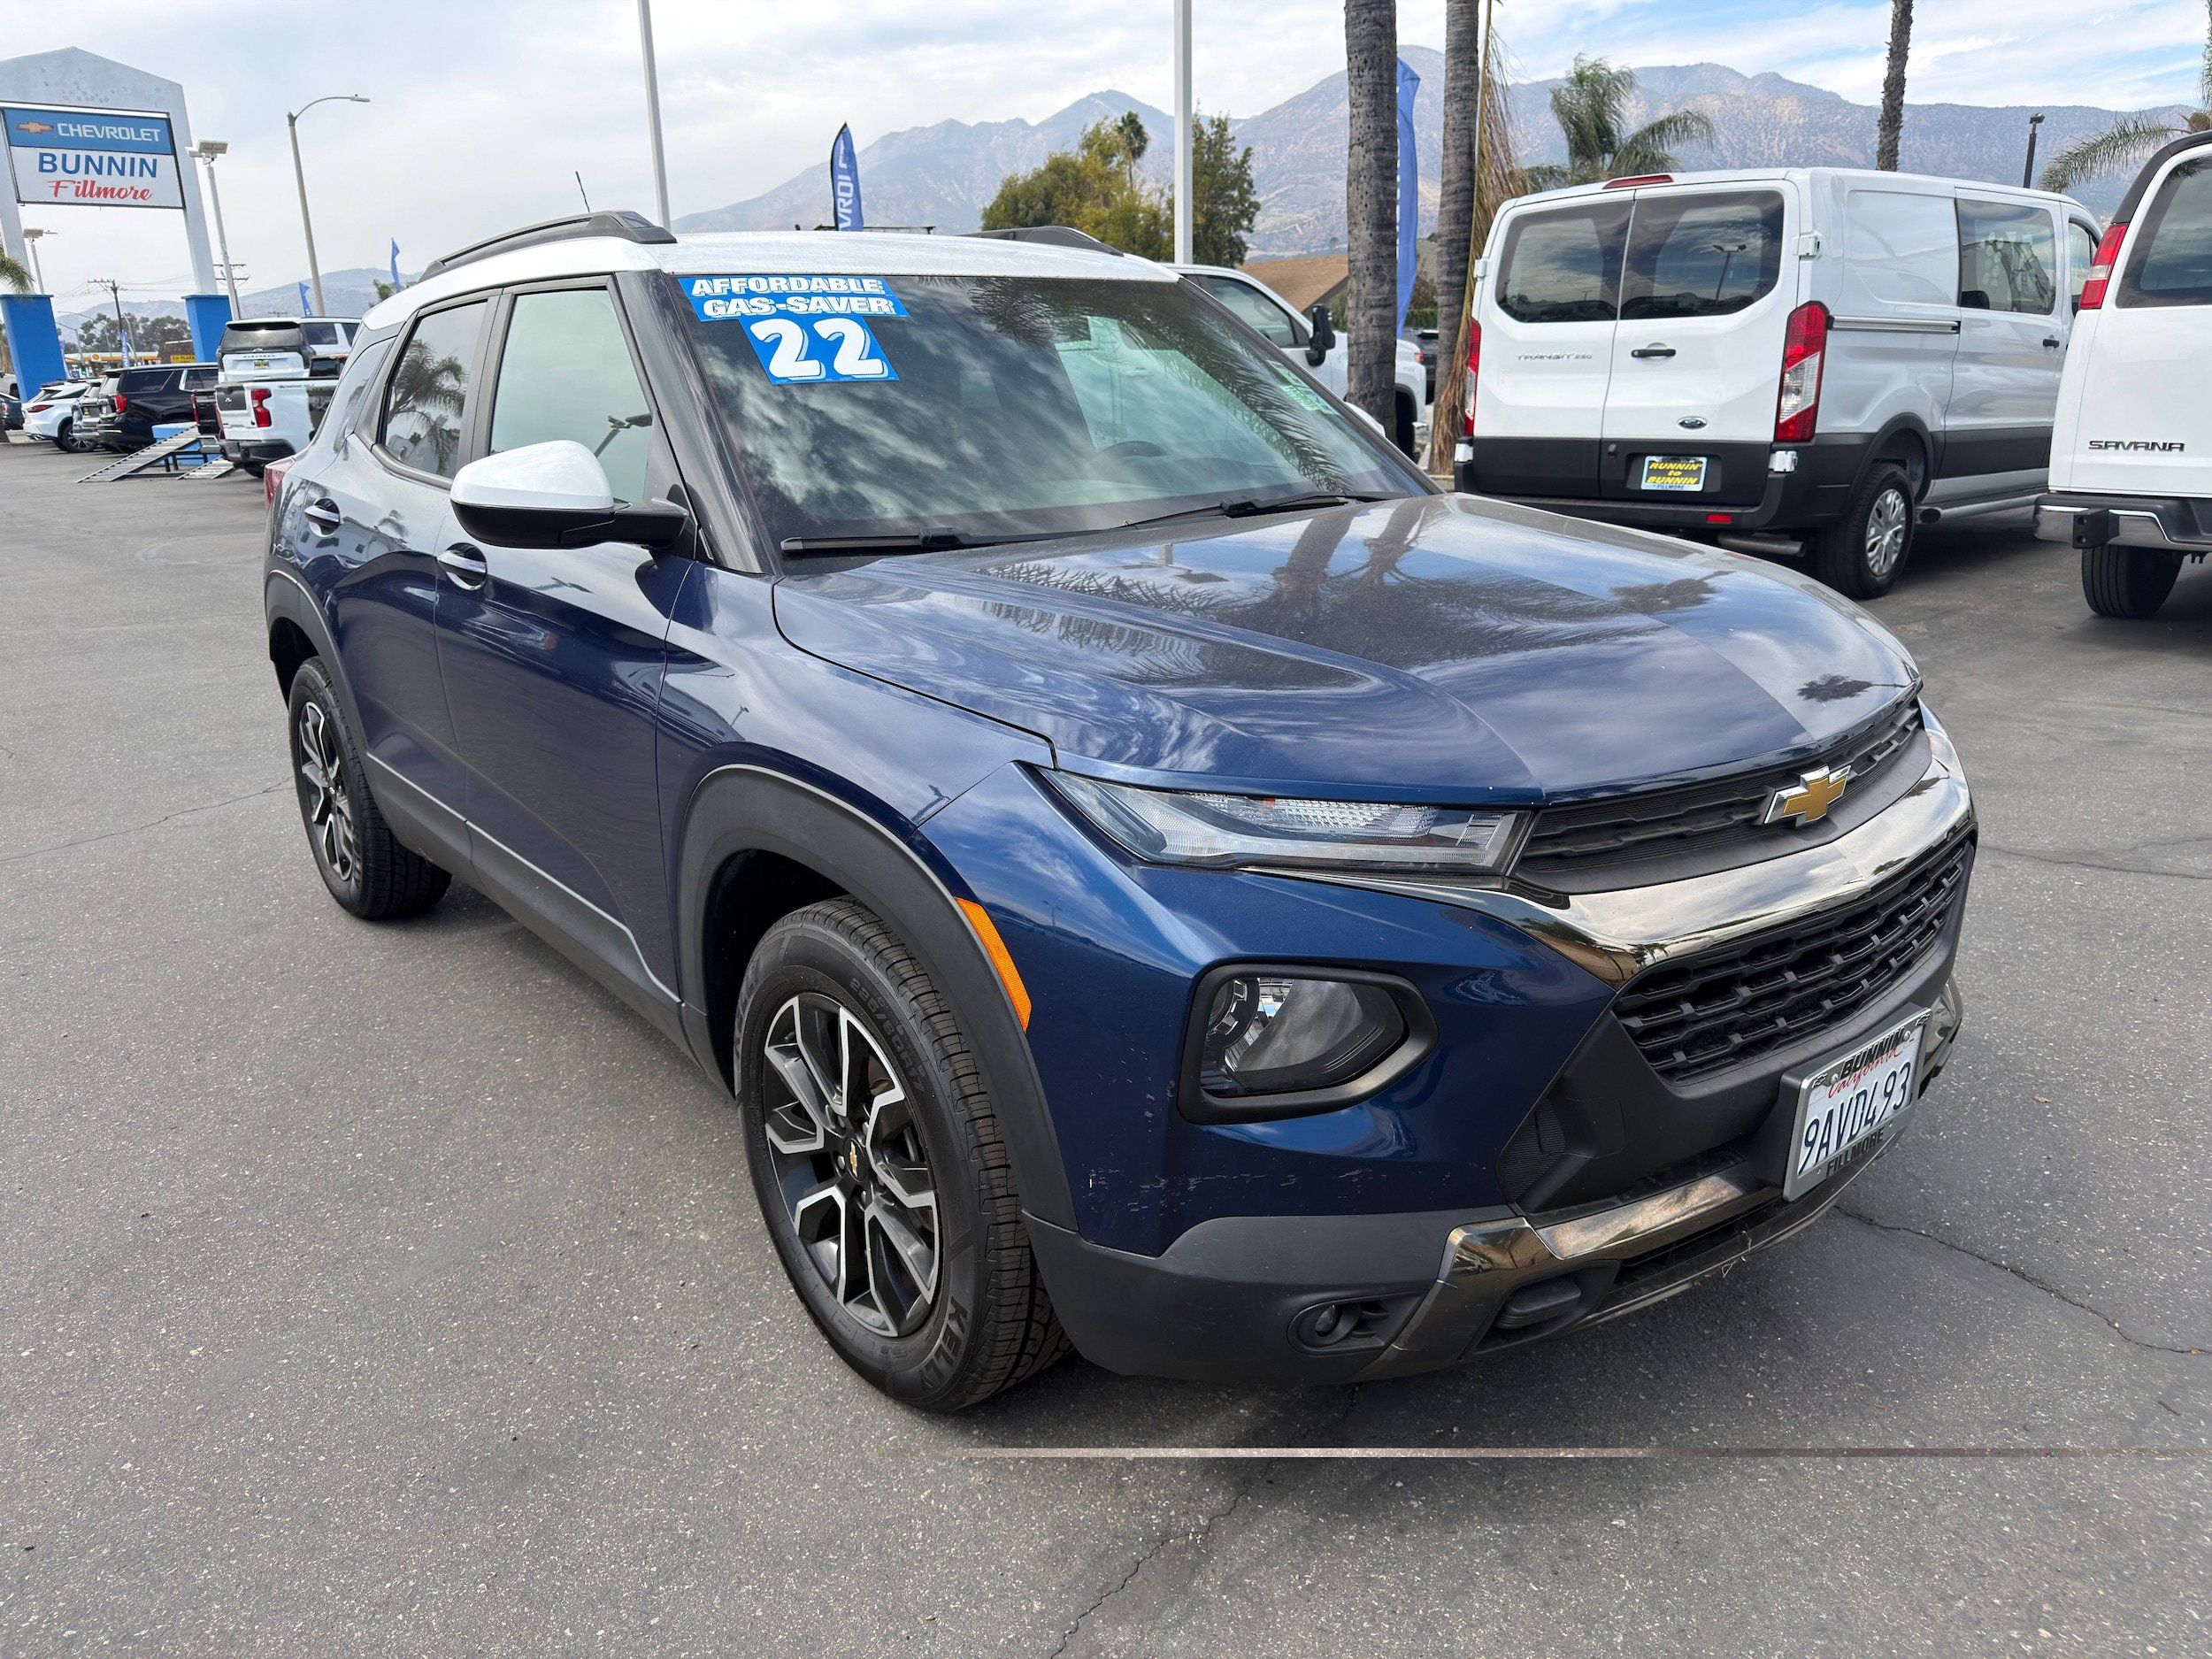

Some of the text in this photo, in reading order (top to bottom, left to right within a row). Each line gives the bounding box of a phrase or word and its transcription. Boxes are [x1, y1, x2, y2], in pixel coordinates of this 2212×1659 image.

[57, 122, 160, 142] CHEVROLET
[38, 152, 157, 178] BUNNIN
[46, 180, 153, 201] Fillmore
[691, 277, 886, 296] AFFORDABLE
[703, 296, 896, 318] GAS-SAVER
[749, 317, 889, 381] 22
[2088, 440, 2185, 452] SAVANA
[1839, 1025, 1905, 1080] BUNNIN
[1797, 1061, 1911, 1175] 9AVD493
[1825, 1126, 1886, 1178] FILLMORE
[918, 1294, 969, 1392] KELLY
